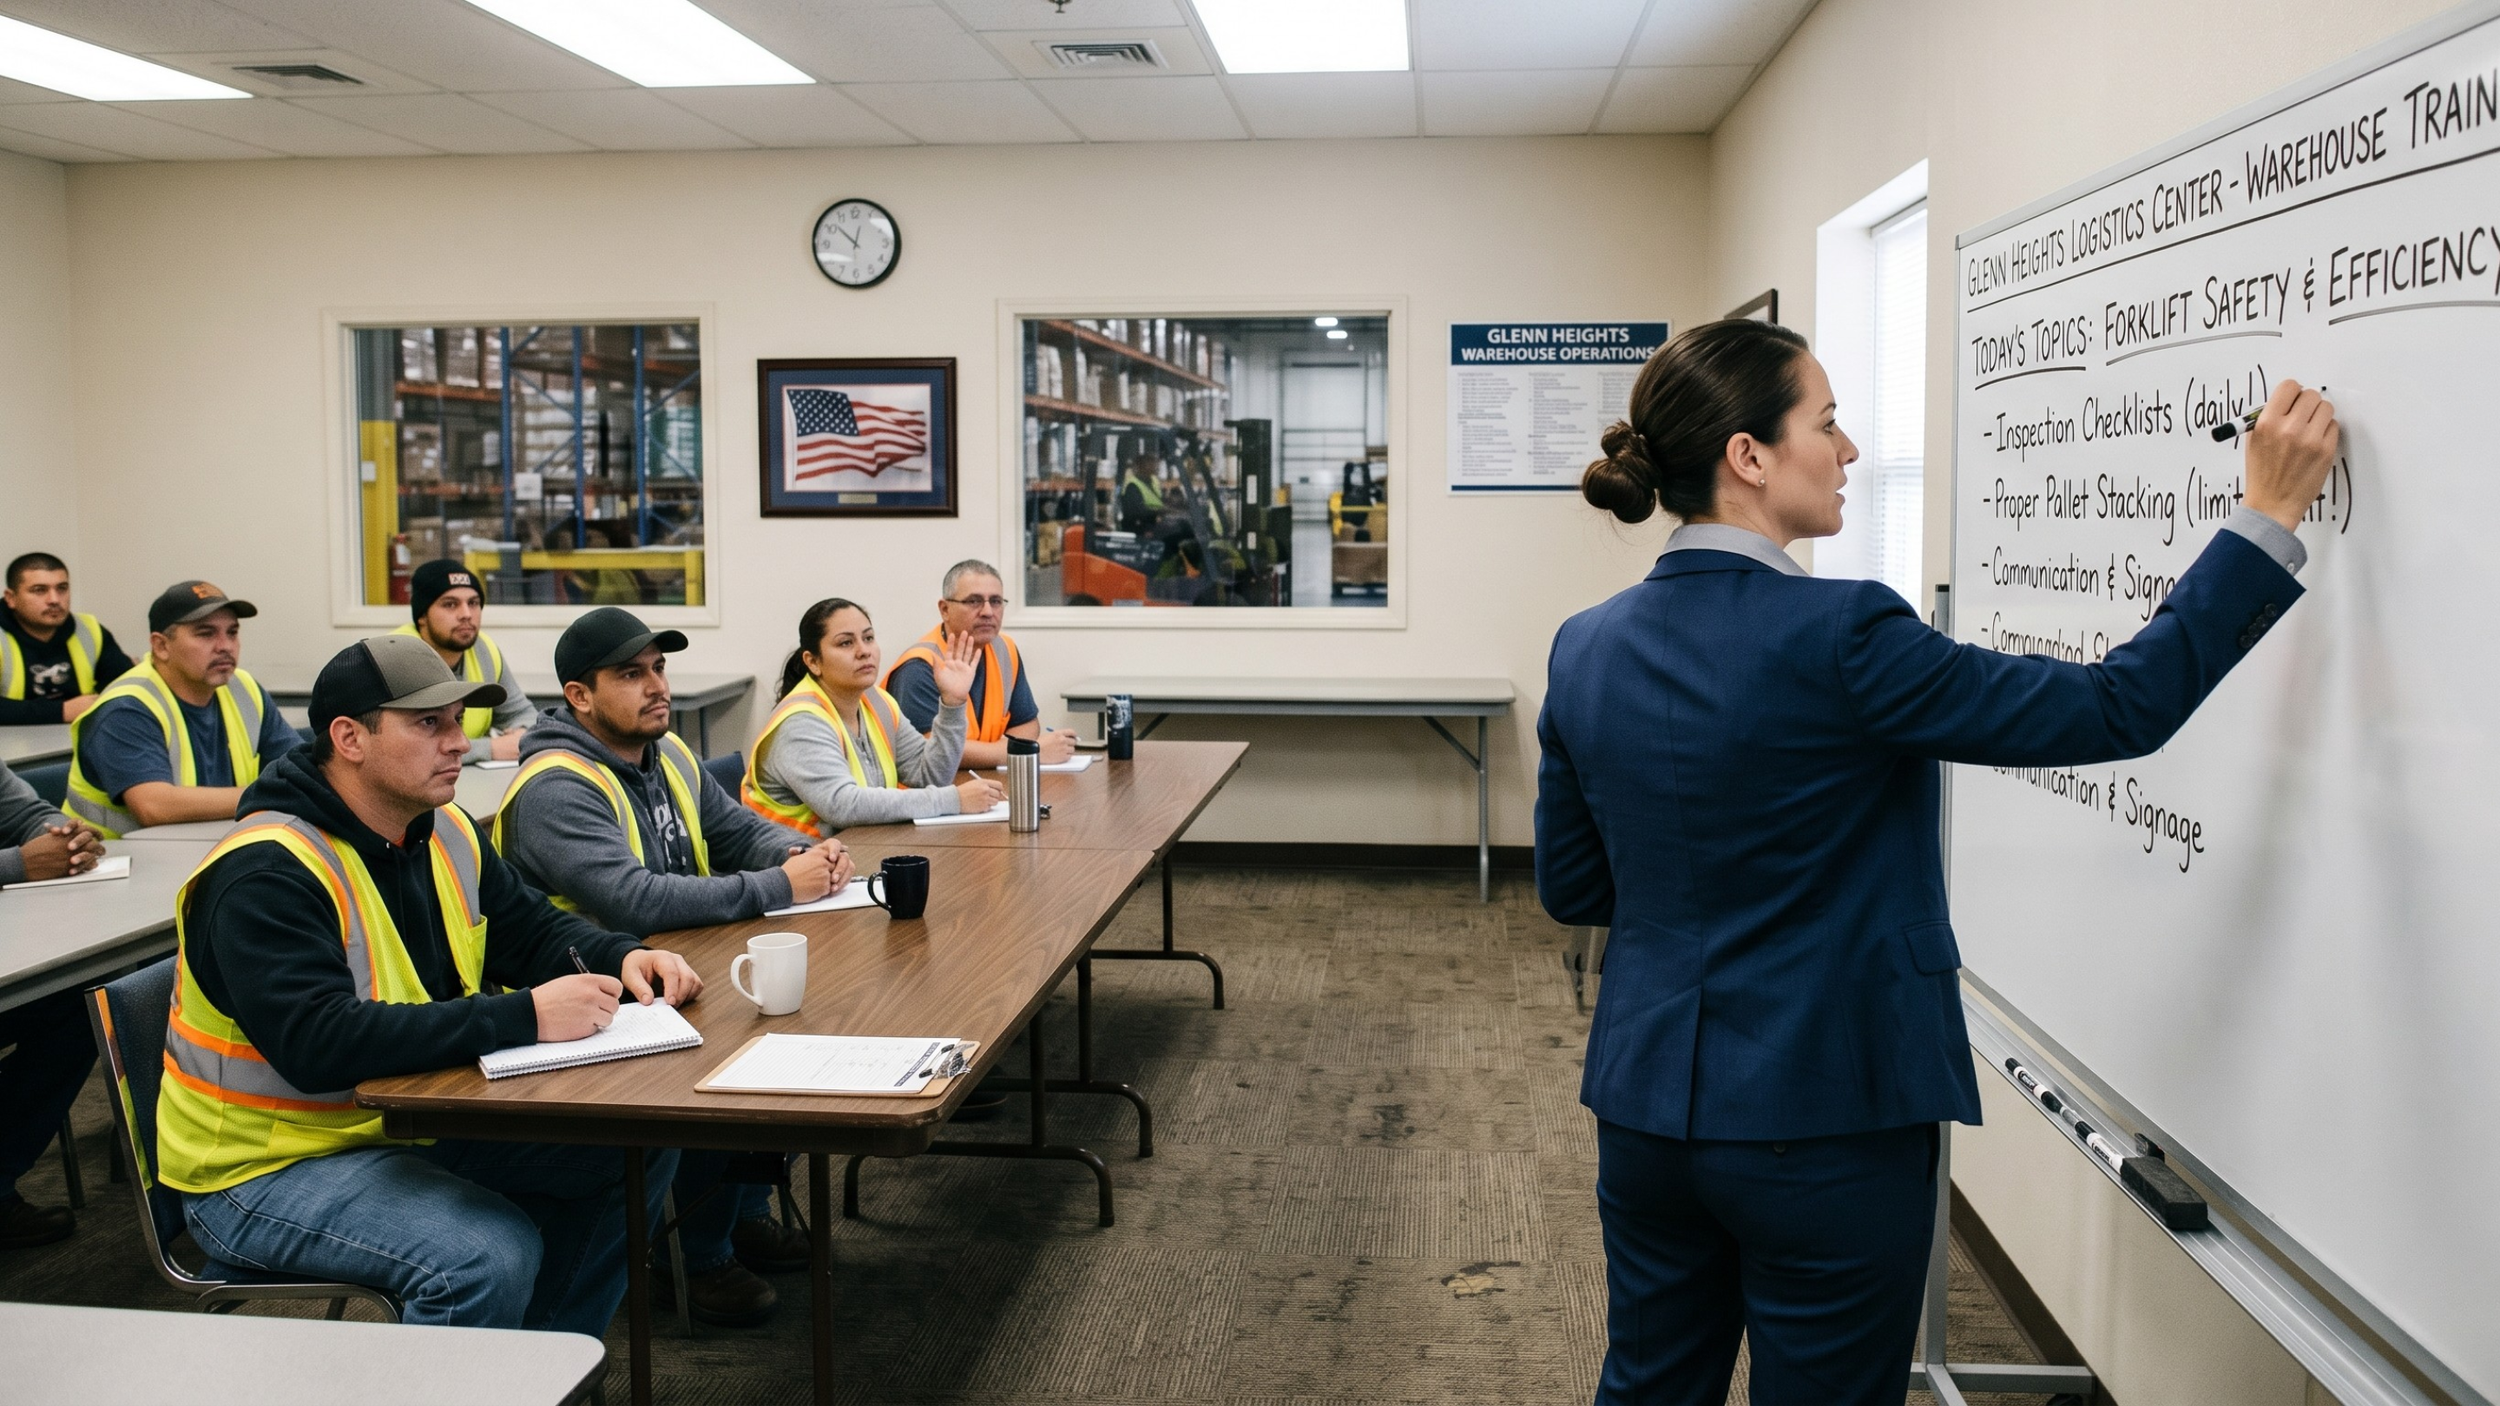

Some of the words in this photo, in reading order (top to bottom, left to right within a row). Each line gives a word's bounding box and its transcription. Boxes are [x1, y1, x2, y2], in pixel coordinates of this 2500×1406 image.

[1967, 250, 2007, 298] GLENN
[2011, 228, 2065, 284] HEIGHTS
[2071, 198, 2145, 264] LOGISTICS
[2152, 168, 2223, 235] CENTER
[2245, 106, 2388, 205] WAREHOUSE
[1461, 347, 1557, 361] WAREHOUSE
[1559, 346, 1656, 361] OPERATIONS
[1487, 328, 1548, 344] GLENN
[1552, 327, 1630, 343] HEIGHTS
[1971, 323, 2026, 377] TODAY'S
[2030, 314, 2093, 363] TOPICS:
[2105, 289, 2193, 351] FORKLIFT
[2202, 266, 2292, 330] SAFETY
[2081, 388, 2173, 443] Checklists
[2045, 473, 2090, 520] Pallet
[2096, 472, 2176, 547] Stacking
[2124, 776, 2205, 874] Signage
